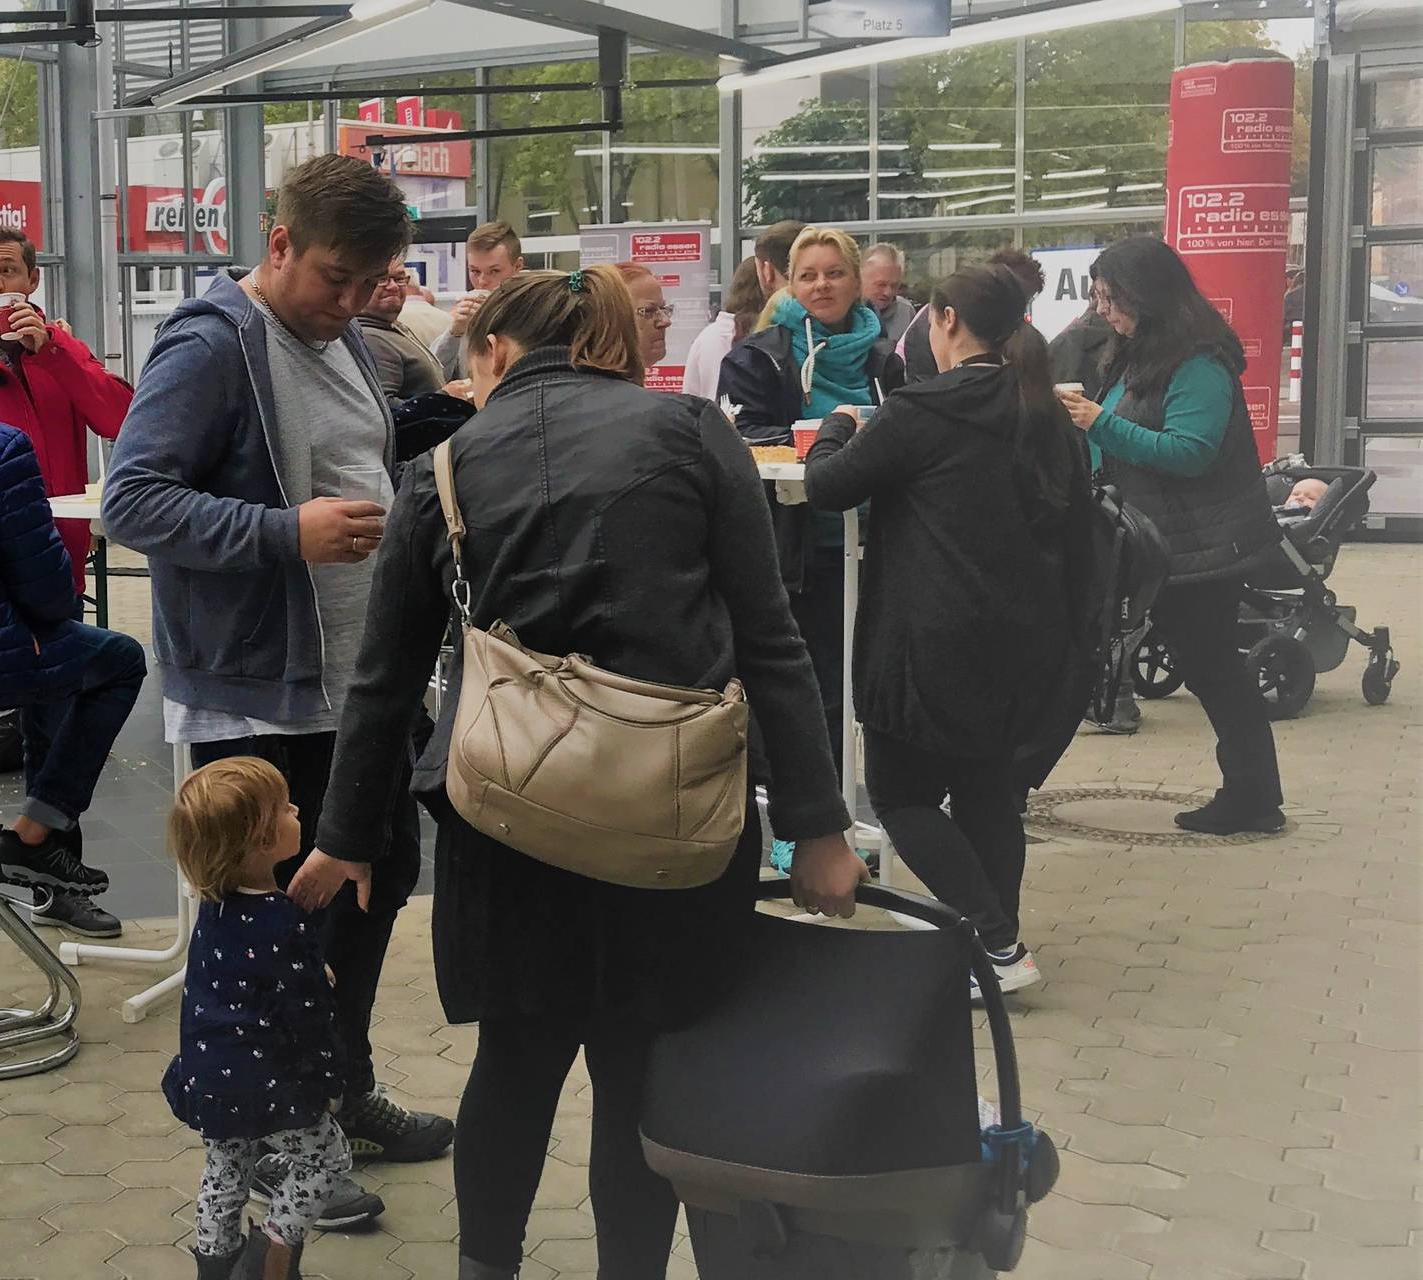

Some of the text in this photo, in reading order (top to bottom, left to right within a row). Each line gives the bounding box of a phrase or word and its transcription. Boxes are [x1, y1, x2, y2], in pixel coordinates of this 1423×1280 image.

[863, 19, 903, 31] Platz 5
[1230, 112, 1268, 123] 102.2
[1237, 123, 1273, 133] radio
[1186, 192, 1245, 209] 102.2
[154, 200, 218, 228] reien
[1194, 208, 1256, 223] radio
[635, 236, 661, 244] 102.2
[1217, 239, 1234, 247] von
[639, 243, 665, 251] radio
